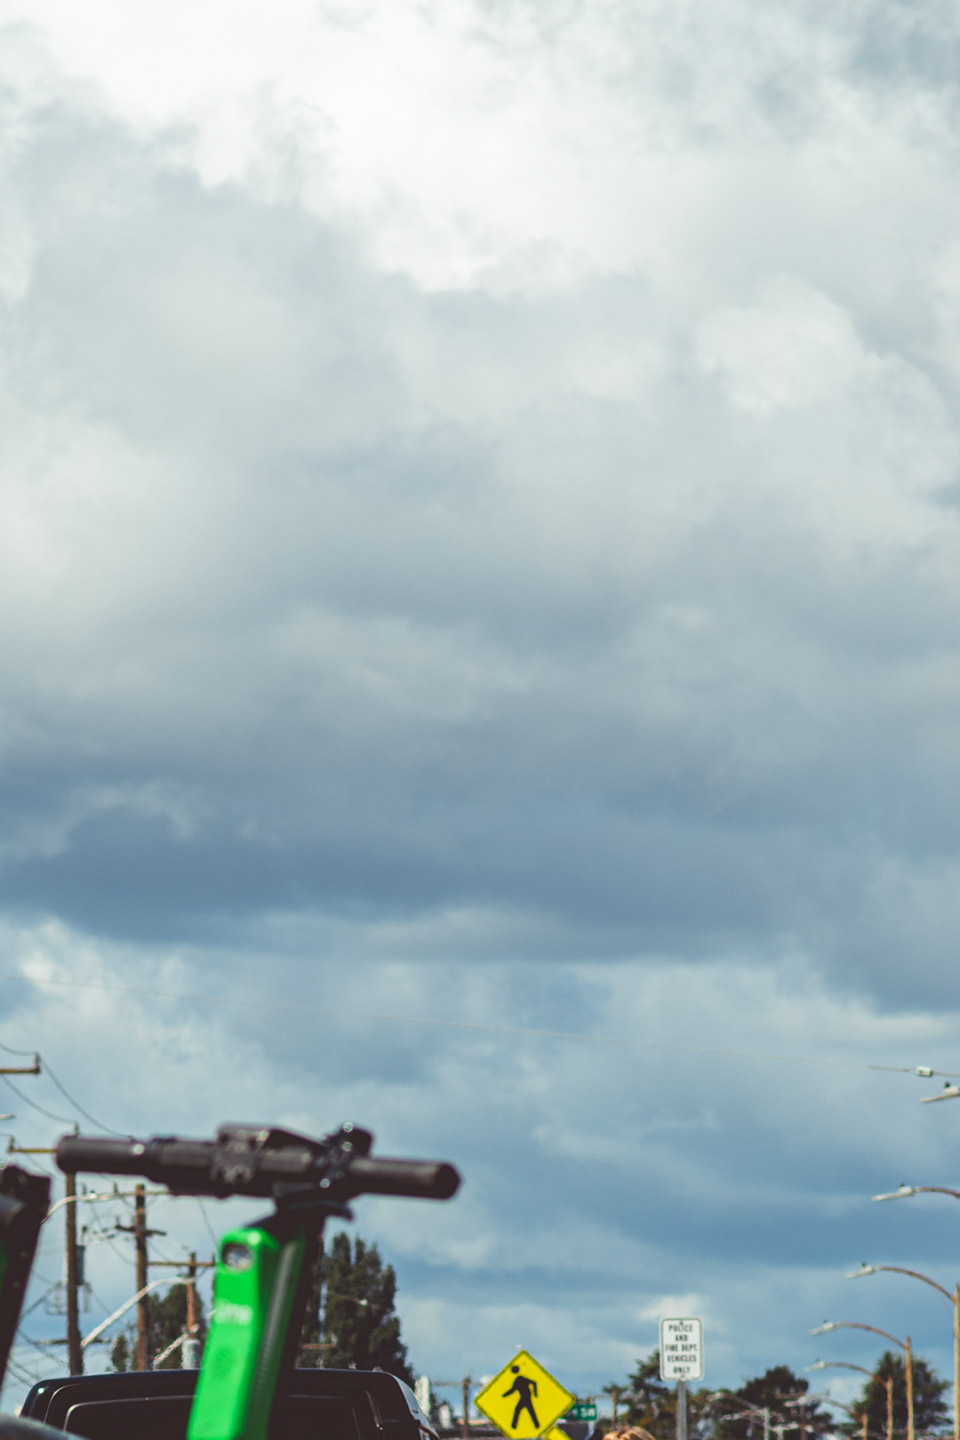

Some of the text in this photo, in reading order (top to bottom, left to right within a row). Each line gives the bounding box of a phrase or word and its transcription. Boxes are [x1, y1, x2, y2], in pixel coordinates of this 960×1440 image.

[668, 1323, 693, 1333] POLICE
[675, 1334, 688, 1342] AND
[665, 1344, 679, 1352] FIRE
[667, 1354, 697, 1362] VEHICLES
[673, 1366, 690, 1374] ONLY
